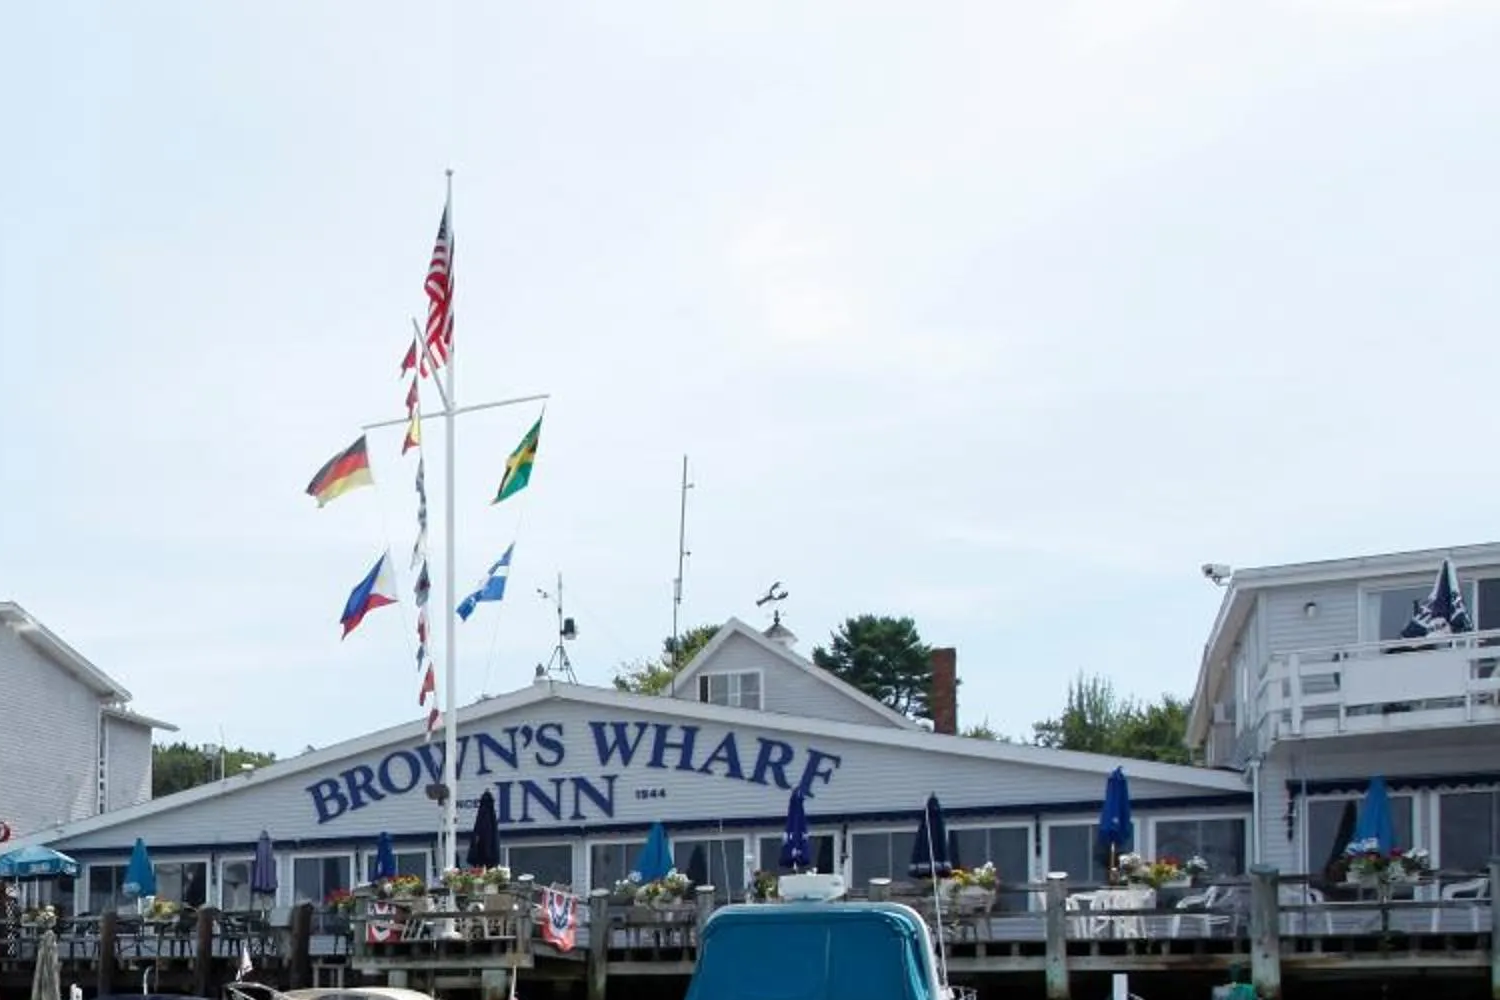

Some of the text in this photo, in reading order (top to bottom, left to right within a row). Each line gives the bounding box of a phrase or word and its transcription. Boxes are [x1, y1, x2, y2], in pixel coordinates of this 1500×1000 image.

[305, 721, 842, 825] BROWN'S WHARF
[494, 775, 619, 824] INN
